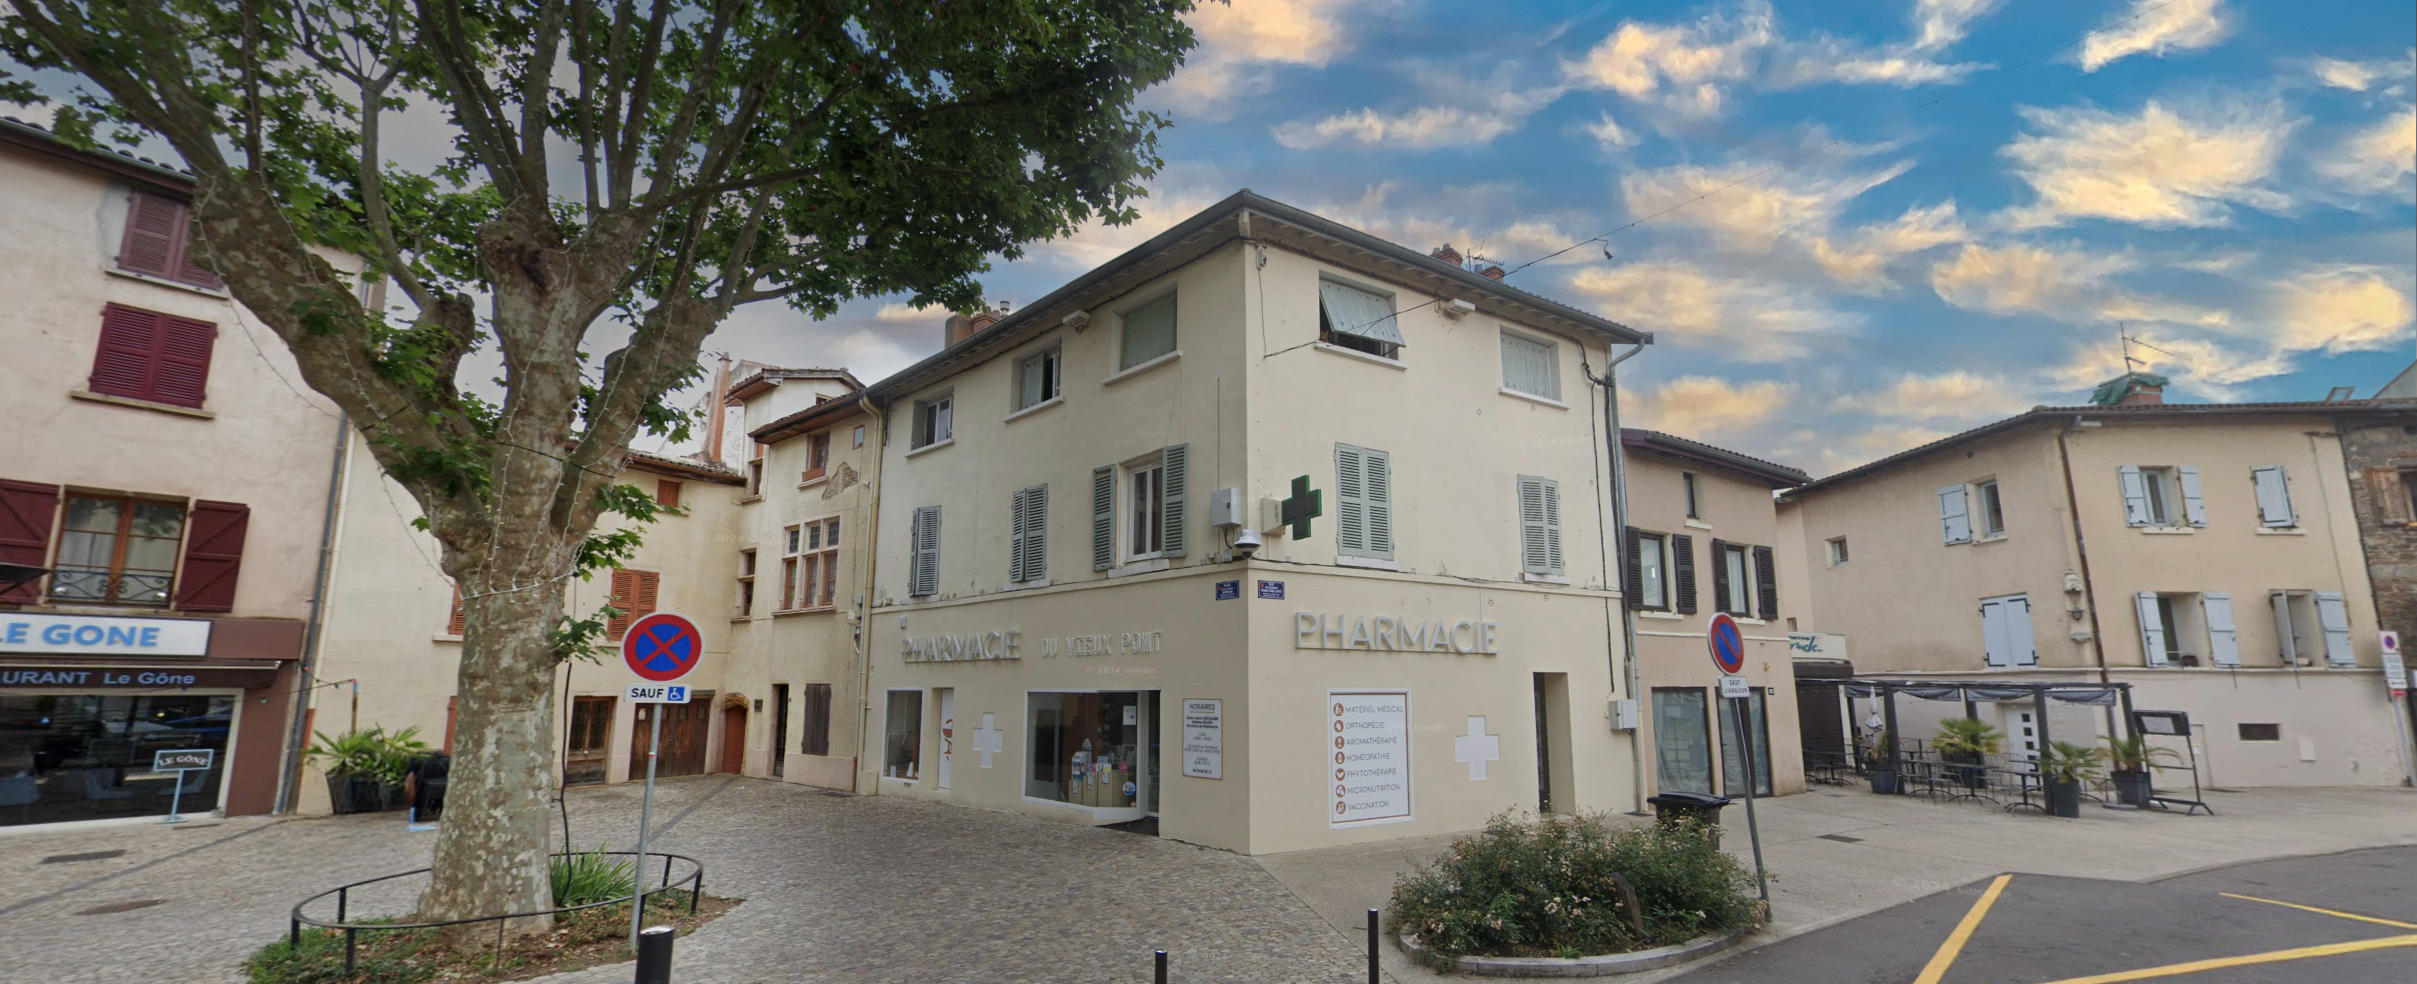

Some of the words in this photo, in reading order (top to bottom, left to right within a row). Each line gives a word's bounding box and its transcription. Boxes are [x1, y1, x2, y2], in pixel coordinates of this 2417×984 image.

[0, 623, 30, 644] E
[42, 624, 160, 647] GONE
[1296, 612, 1500, 654] PHARMACIE
[901, 631, 1021, 662] PHARMACIE
[1041, 639, 1058, 657] DU
[1066, 635, 1112, 656] VIEUX
[1121, 630, 1162, 653] PONT
[103, 672, 130, 685] Le
[138, 672, 196, 685] Gône
[631, 688, 664, 698] SAUF
[1189, 703, 1215, 711] HORAIRES
[1377, 705, 1404, 713] MÉDICAL
[1346, 737, 1397, 745] AROMATHÉRAPIE
[158, 757, 174, 766] LE
[1347, 753, 1390, 761] HOMÉOPATHIE
[1347, 768, 1397, 778] PHYTOTHÉRAPIE
[1347, 784, 1401, 794] MICRONUTRITION
[1348, 801, 1389, 811] VACCINATION
